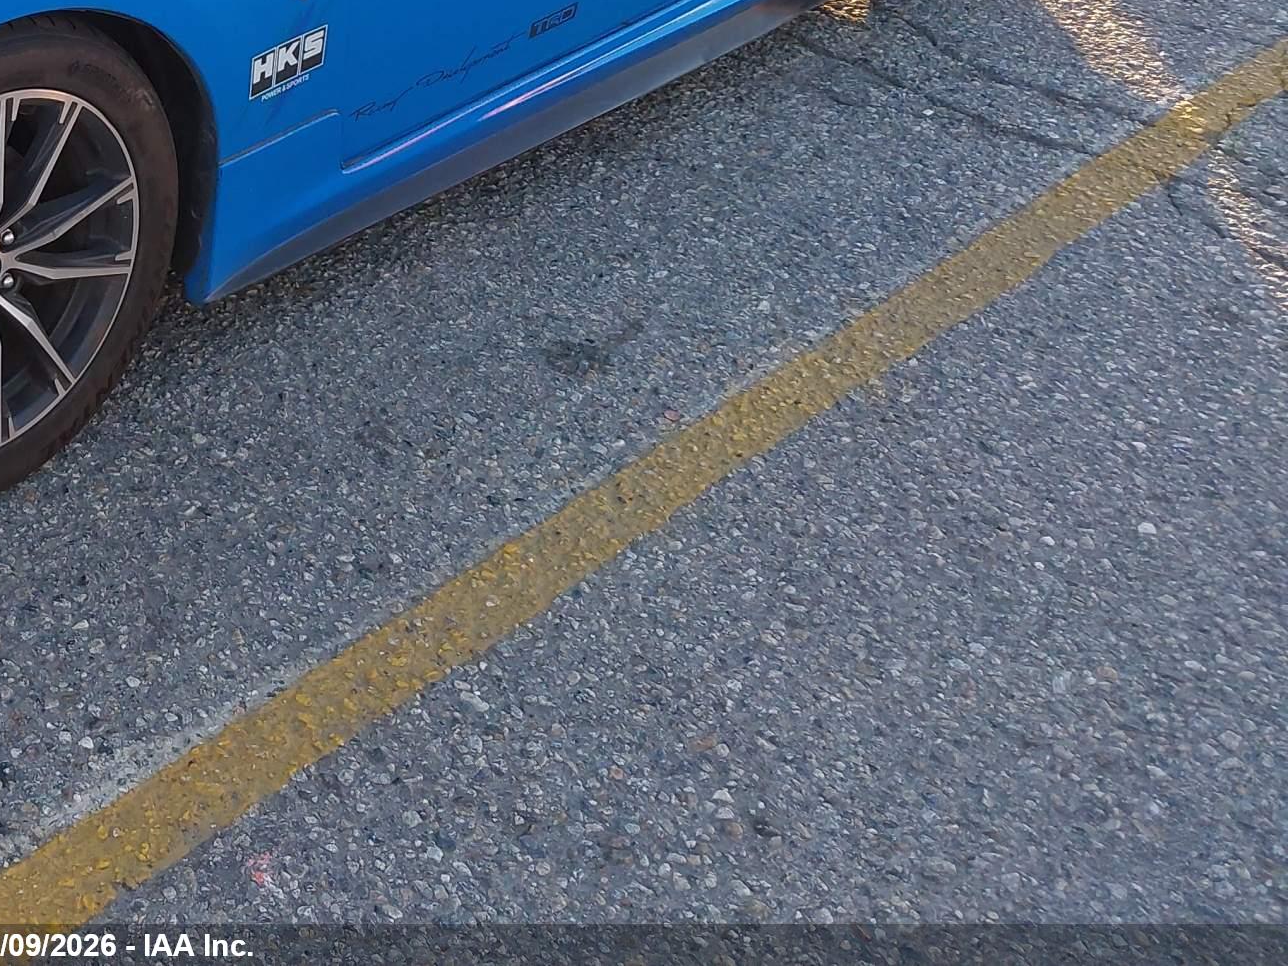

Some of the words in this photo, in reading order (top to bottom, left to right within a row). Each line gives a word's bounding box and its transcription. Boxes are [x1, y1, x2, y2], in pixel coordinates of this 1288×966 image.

[253, 29, 325, 85] HKS
[261, 86, 283, 102] POWER
[286, 73, 310, 91] SPORTS
